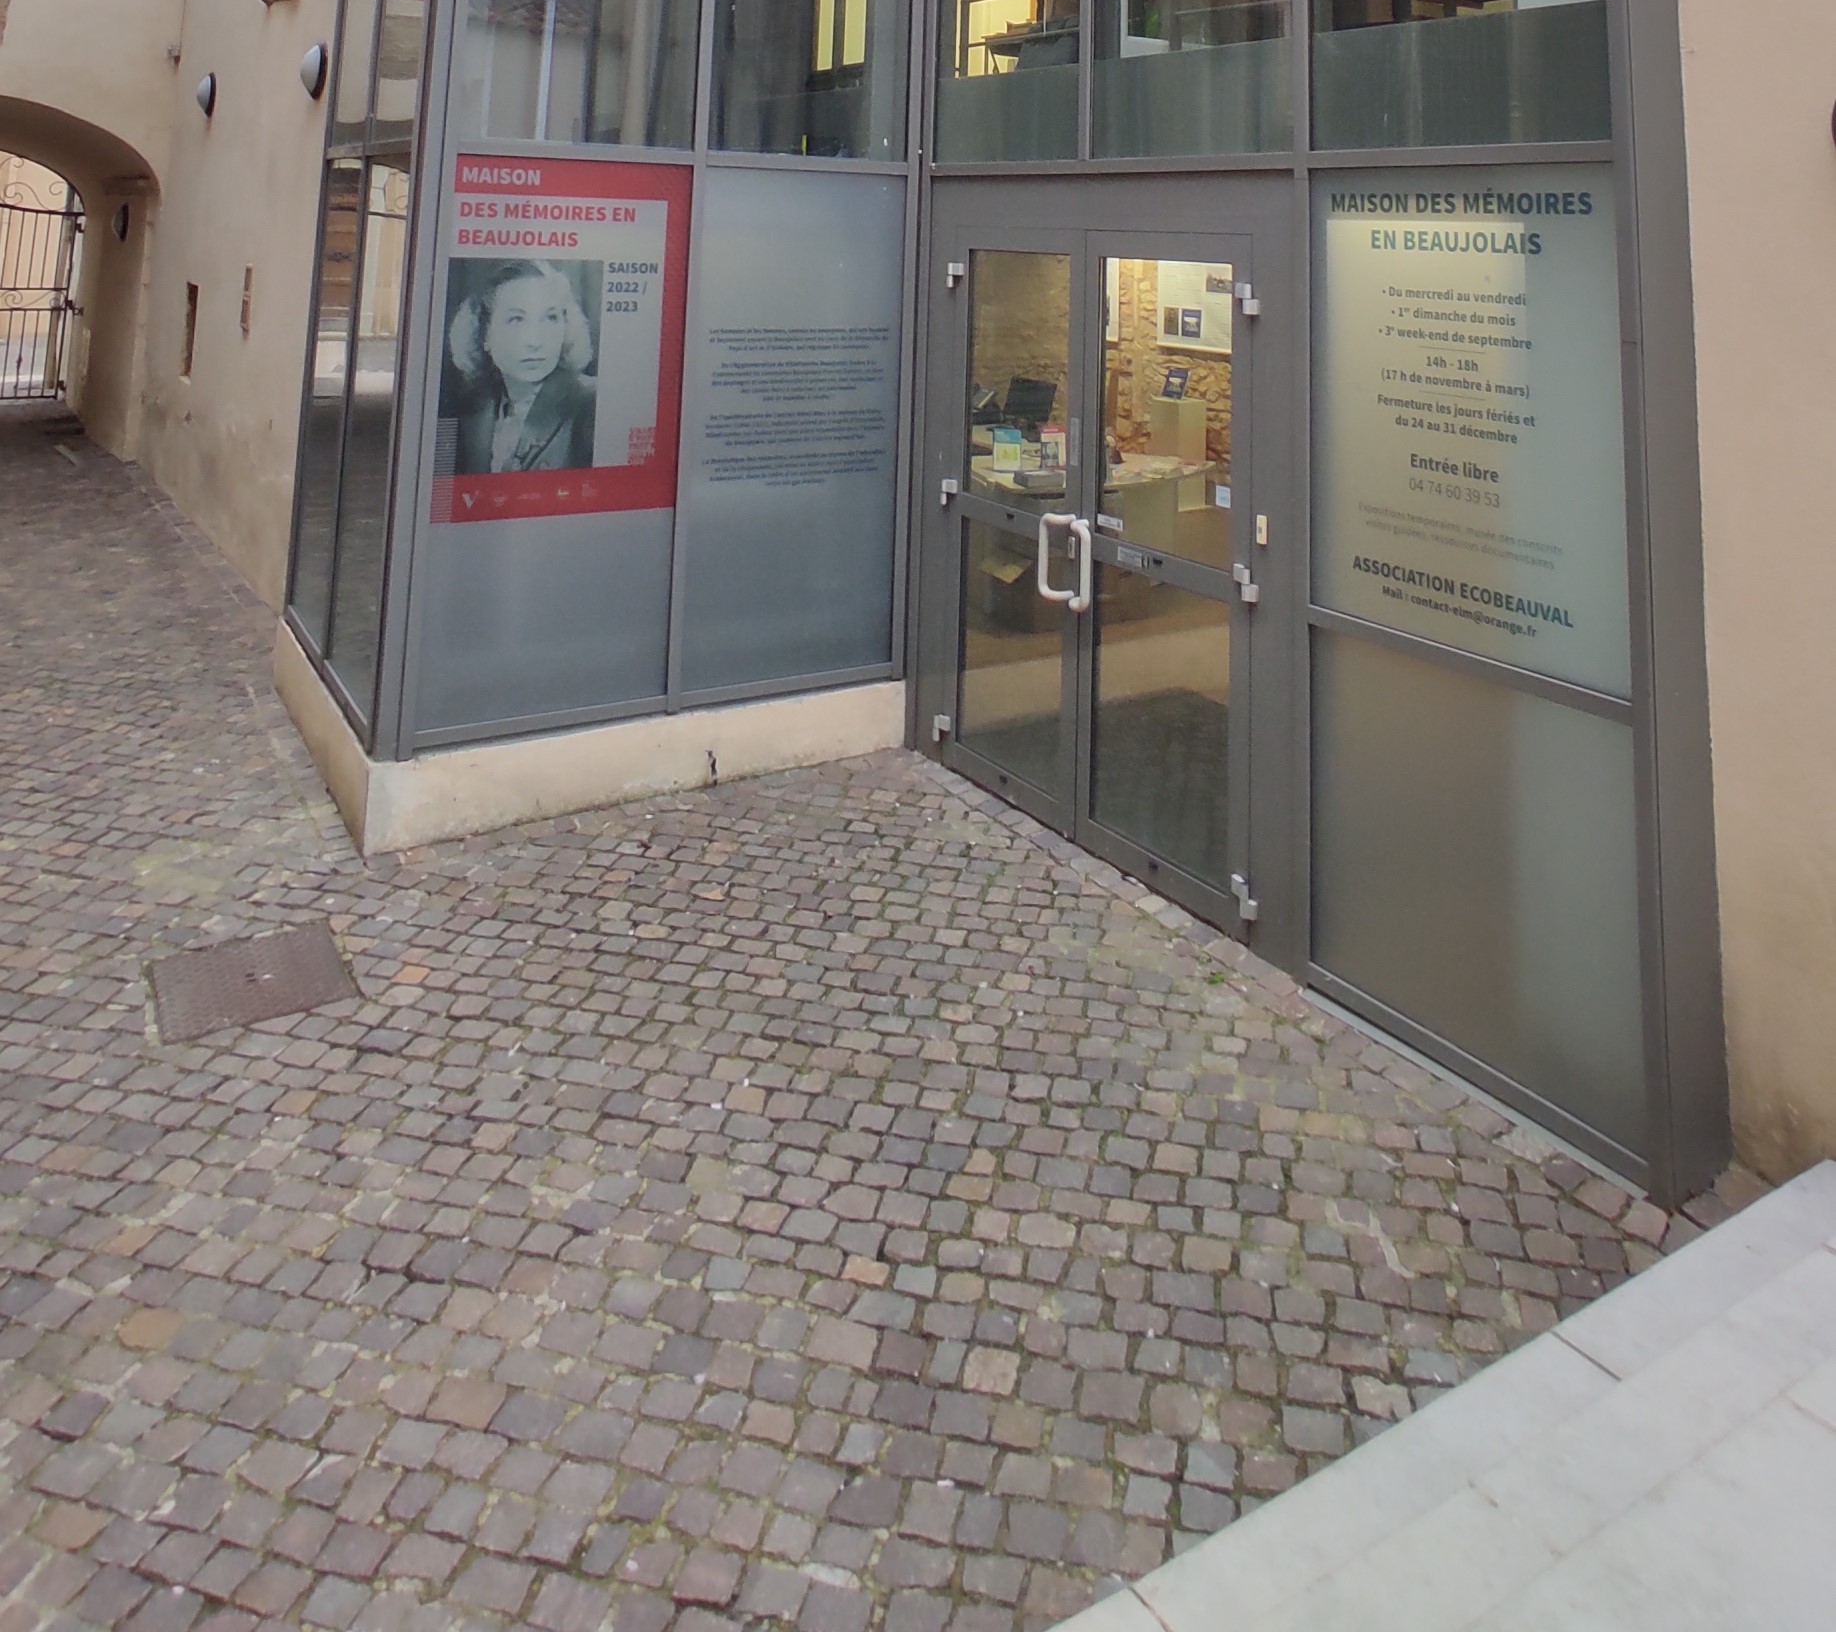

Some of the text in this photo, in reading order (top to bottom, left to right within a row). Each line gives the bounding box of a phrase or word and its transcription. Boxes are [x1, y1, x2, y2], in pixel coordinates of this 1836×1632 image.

[462, 167, 541, 185] MAISON
[460, 200, 636, 222] DES MÉMOIRES EN
[1331, 188, 1593, 216] MAISON DES MÉMOIRES
[457, 229, 579, 247] BEAUJOLAIS
[1371, 229, 1542, 255] EN BEAUJOLAIS
[608, 262, 659, 274] SAISON
[606, 281, 639, 293] 2022
[1388, 286, 1526, 306] Du mercredi au vendredi
[606, 301, 638, 312] 2023
[1413, 307, 1467, 323] dimanche
[1470, 312, 1485, 324] du
[1487, 314, 1516, 327] mois
[1397, 327, 1449, 342] week-end
[1451, 331, 1465, 343] de
[1468, 334, 1532, 350] septembre
[1426, 356, 1447, 368] 14h
[1457, 359, 1479, 372] 18h
[1381, 368, 1530, 399] (17 h de novembre à mars)
[1377, 394, 1536, 427] Fermeture les jours fériés et
[1395, 415, 1517, 444] du 24 au 31 décembre
[1410, 453, 1499, 483] Entrée libre
[1409, 477, 1500, 508] 04 74 60 39 53
[1352, 555, 1573, 628] ASSOCIATION ECOBEAUVAL
[1382, 585, 1403, 601] Mail
